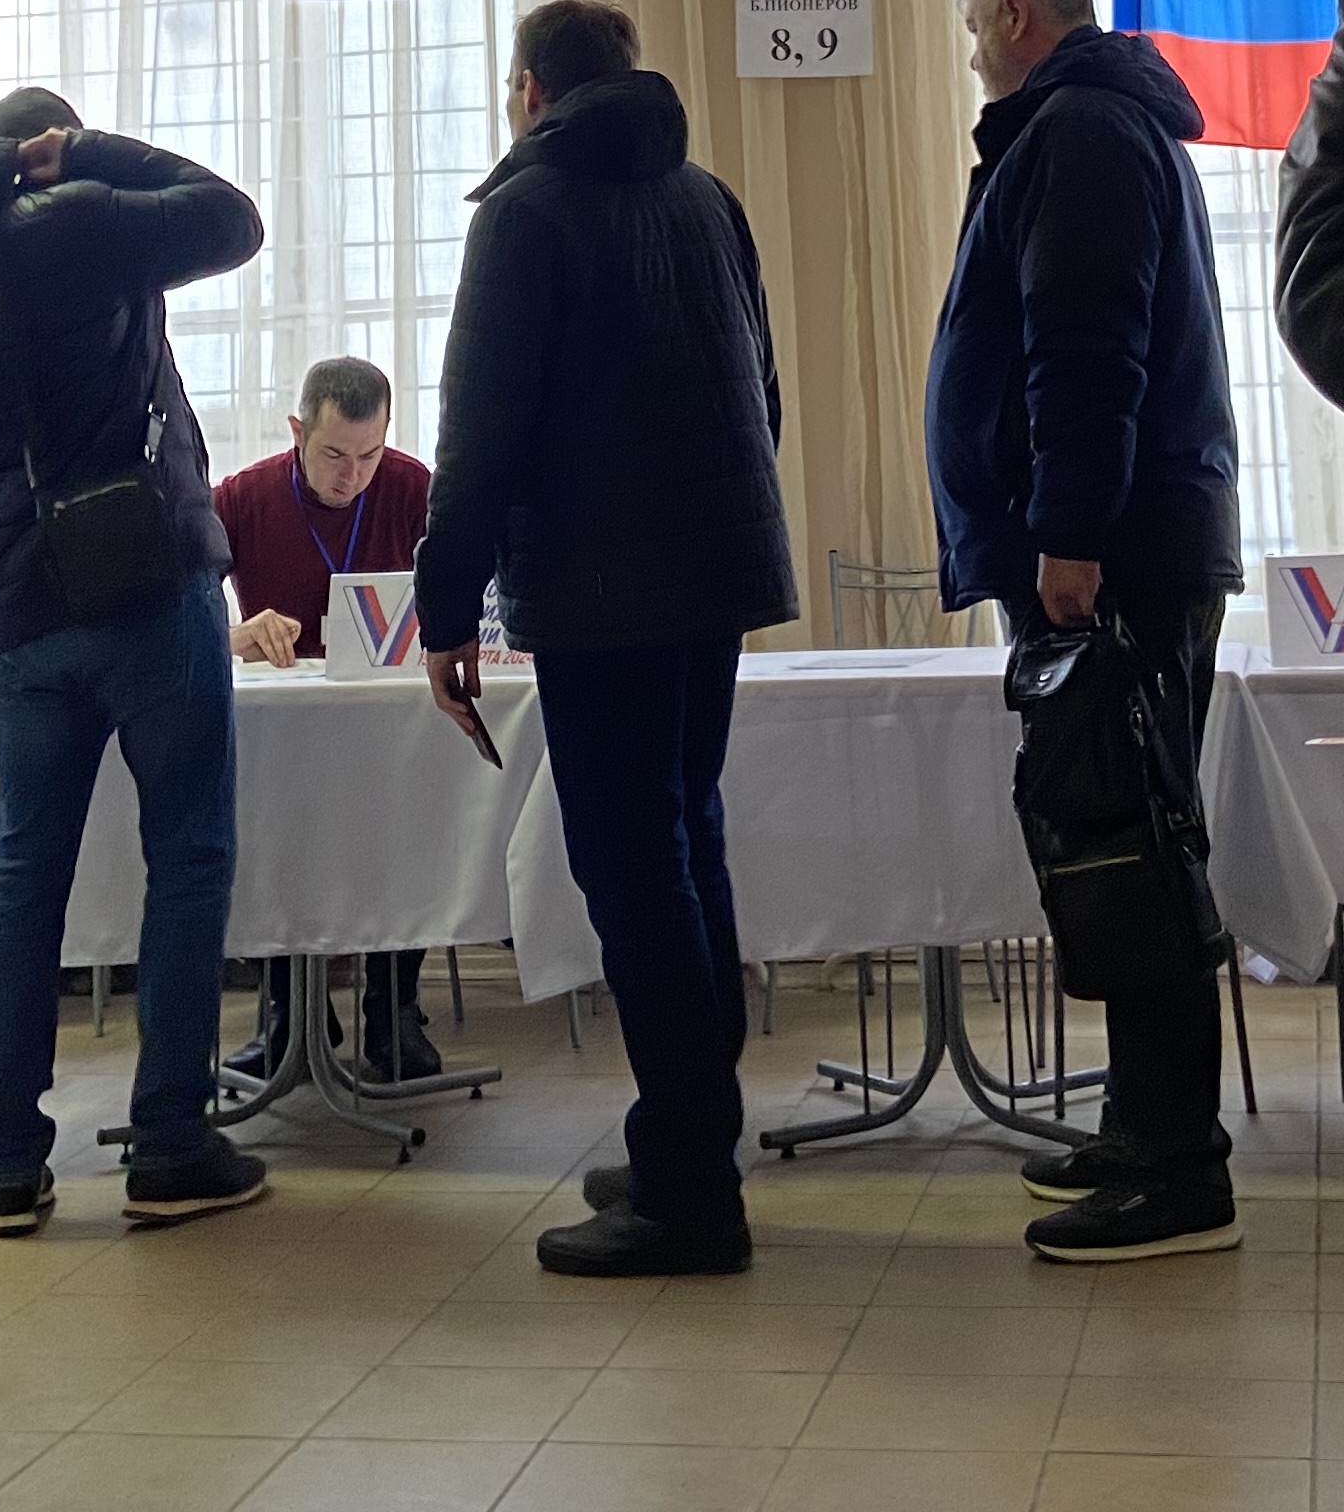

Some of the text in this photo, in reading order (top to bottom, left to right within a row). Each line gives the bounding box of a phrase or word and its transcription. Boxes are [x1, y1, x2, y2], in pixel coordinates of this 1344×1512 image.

[771, 28, 838, 68] 8, 9
[478, 650, 502, 666] РТА
